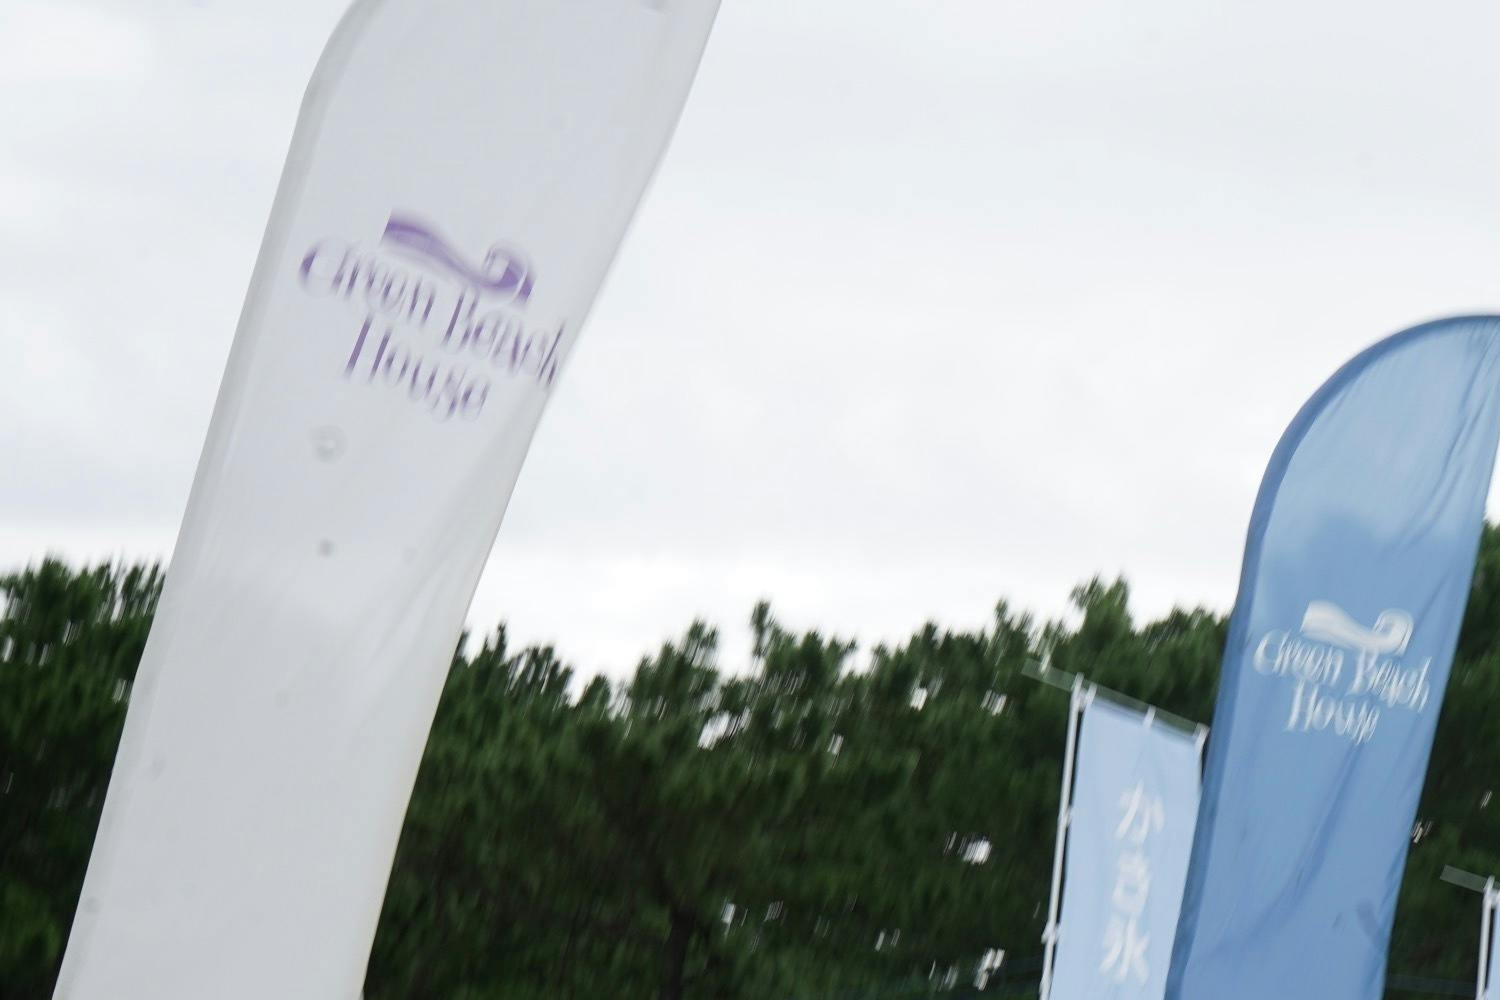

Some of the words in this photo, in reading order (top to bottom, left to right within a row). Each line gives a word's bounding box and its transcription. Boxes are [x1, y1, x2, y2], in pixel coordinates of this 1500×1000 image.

[343, 312, 490, 421] House
[1100, 779, 1165, 986] かき氷
